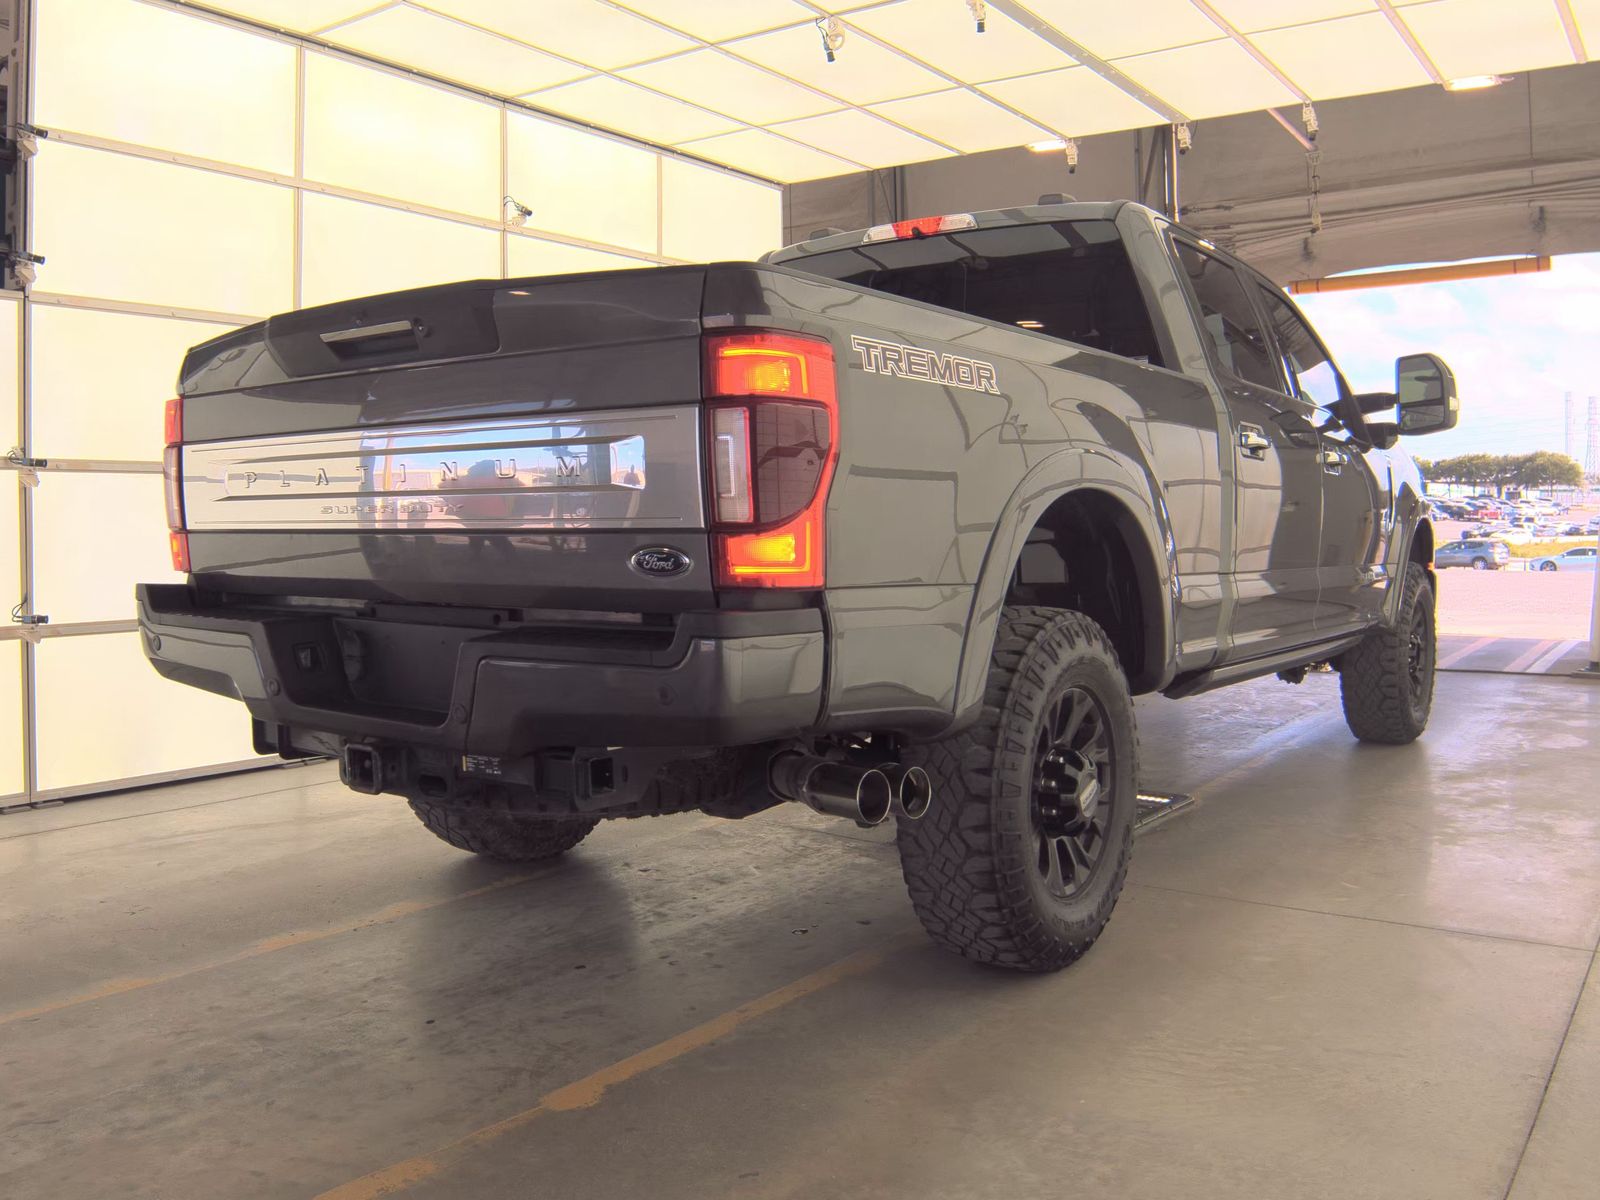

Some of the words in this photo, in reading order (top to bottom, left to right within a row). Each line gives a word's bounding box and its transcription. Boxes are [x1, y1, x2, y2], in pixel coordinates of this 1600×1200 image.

[850, 334, 1000, 395] TREMOR
[244, 455, 582, 489] PLATINUM
[320, 504, 395, 515] SUPER
[400, 503, 464, 515] DUTY
[642, 553, 675, 570] Ford
